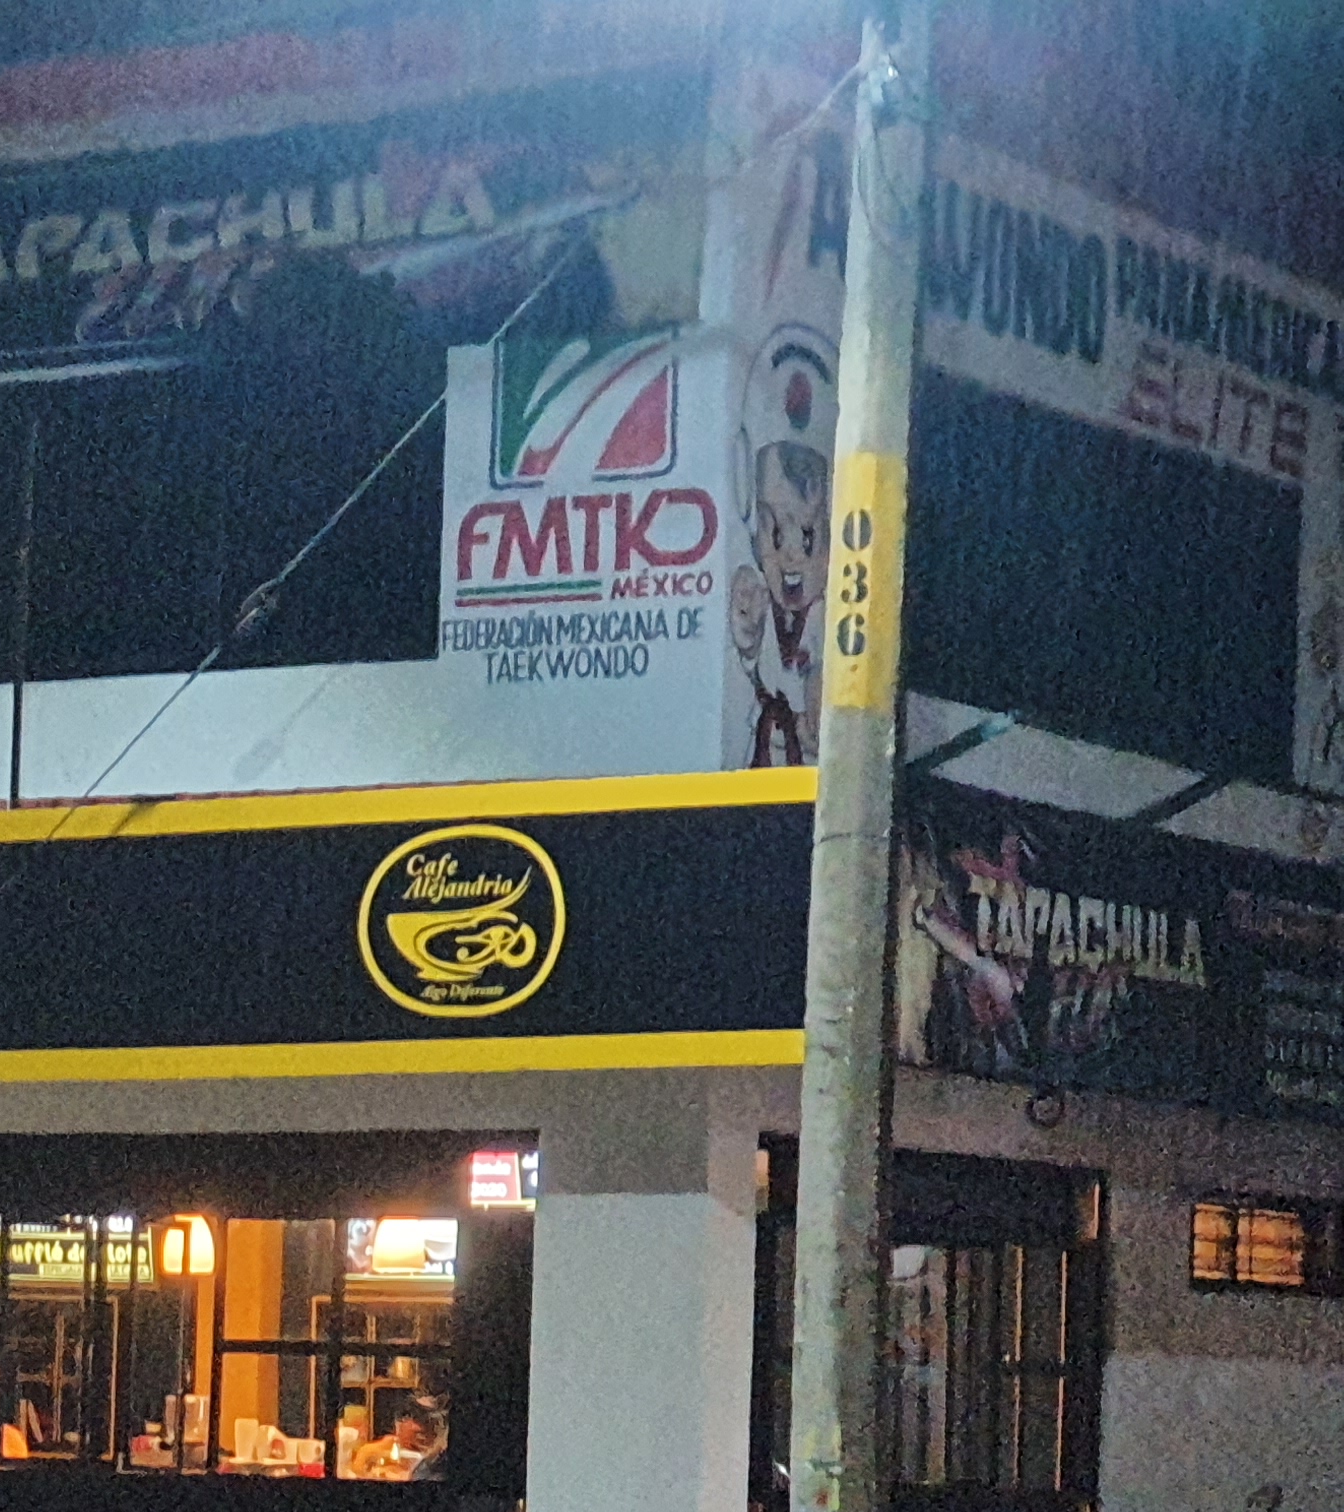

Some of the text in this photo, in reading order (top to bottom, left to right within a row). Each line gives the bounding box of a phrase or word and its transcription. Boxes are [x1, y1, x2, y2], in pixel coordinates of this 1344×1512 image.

[611, 568, 713, 600] MÉXICO
[442, 606, 705, 652] FEDERACIÓN MEXICANA DE
[486, 643, 650, 686] TAEKWONDO
[406, 852, 459, 881] Cafe
[402, 872, 514, 905] Alejandria
